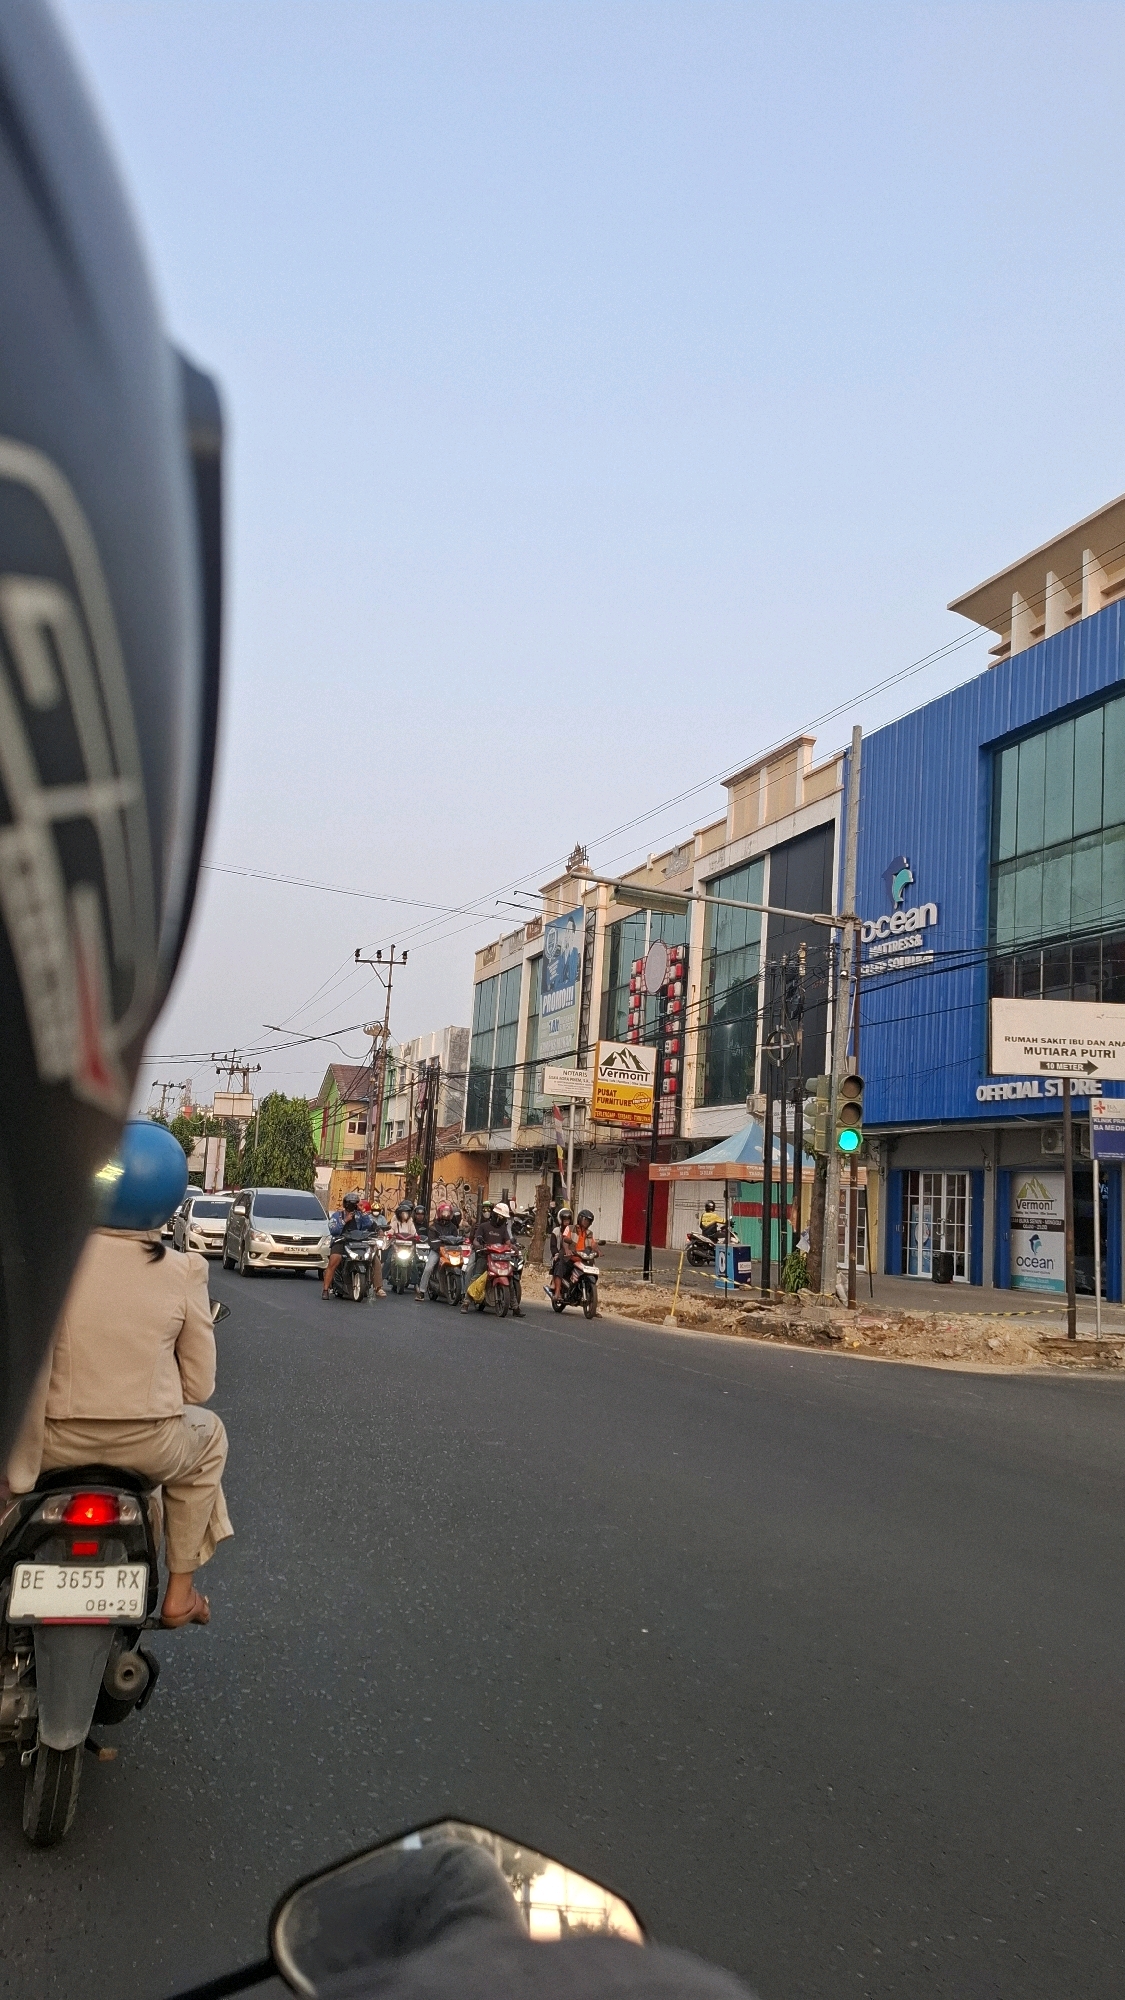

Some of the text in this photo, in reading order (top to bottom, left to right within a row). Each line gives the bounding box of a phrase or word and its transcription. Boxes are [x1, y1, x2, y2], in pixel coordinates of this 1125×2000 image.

[861, 903, 938, 943] ocean
[1004, 1035, 1038, 1043] RUMAH
[1040, 1037, 1067, 1045] SAKIT
[1069, 1038, 1084, 1046] IBU
[1087, 1039, 1106, 1047] DAN
[1023, 1046, 1116, 1059] MUTIARA PUTRI
[1056, 1063, 1084, 1071] METER
[562, 1070, 588, 1078] NOTARIS
[597, 1088, 618, 1097] PUSAT
[976, 1078, 1103, 1101] OFFICIAL STORE
[596, 1097, 632, 1107] FURNITURE
[1016, 1256, 1054, 1270] ocean
[20, 1570, 140, 1590] BE 3655 RX
